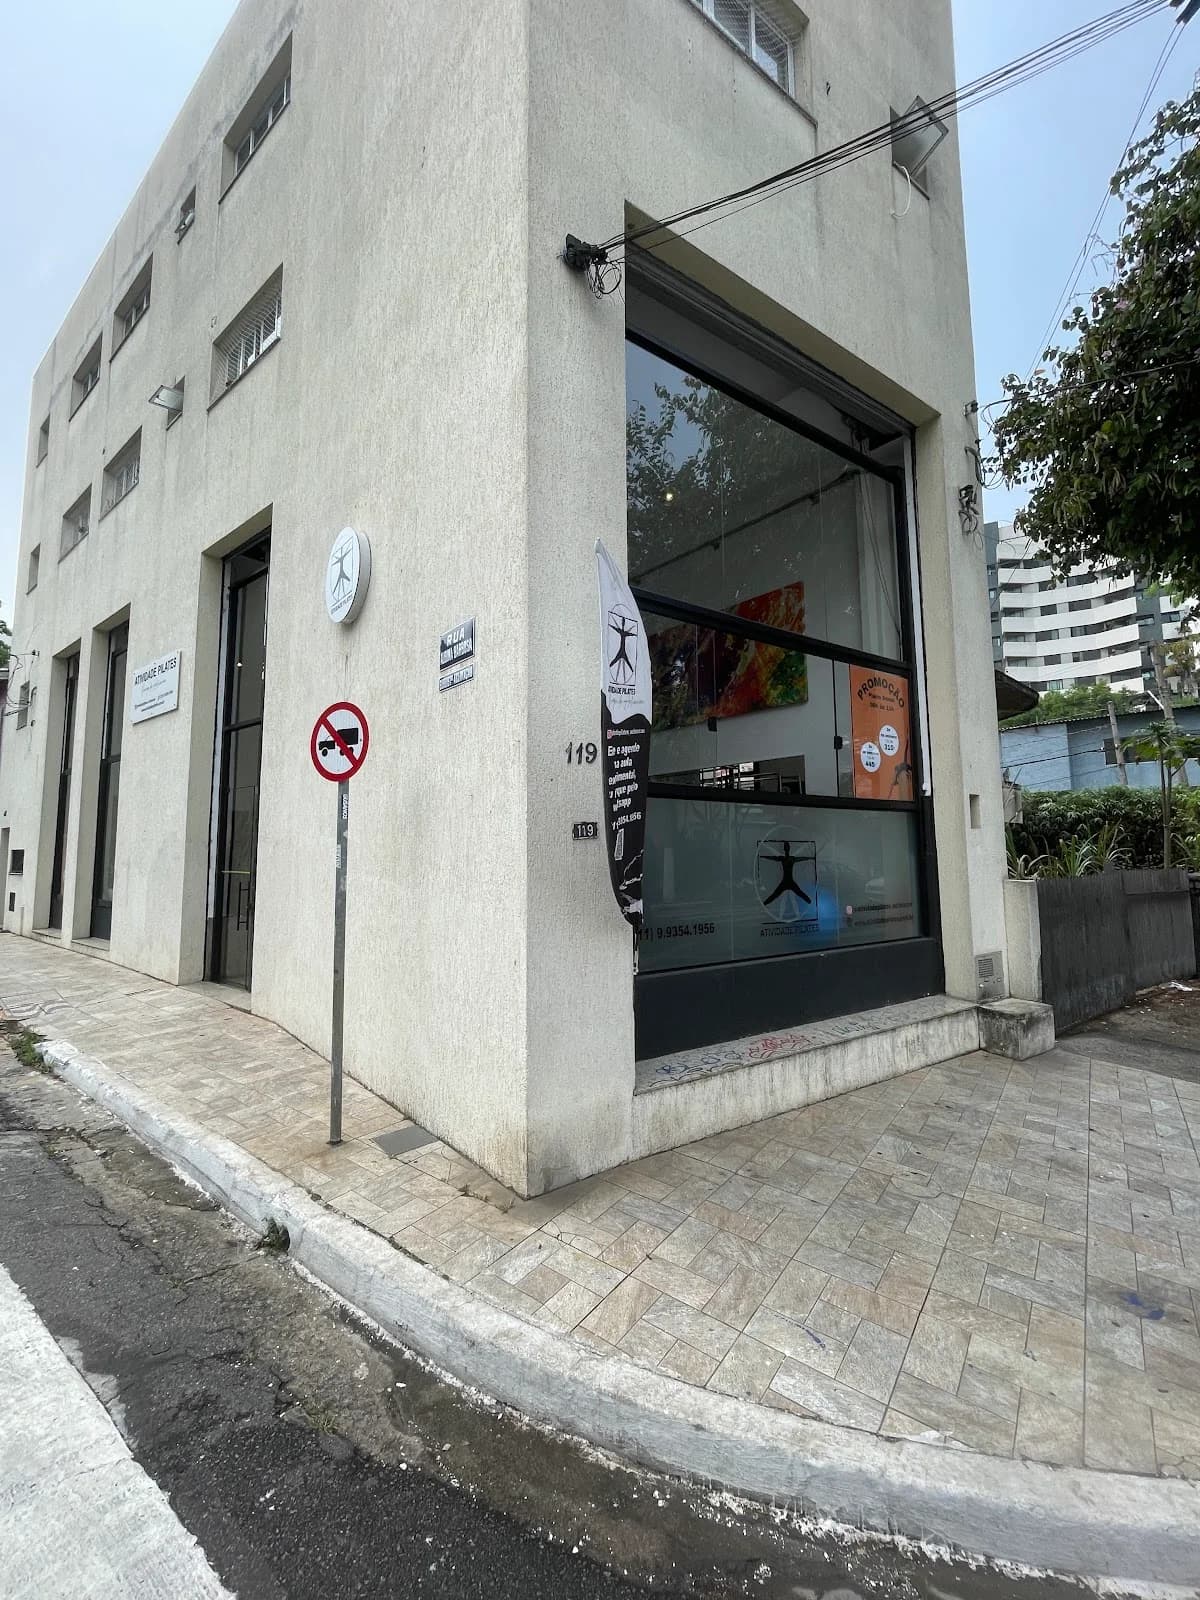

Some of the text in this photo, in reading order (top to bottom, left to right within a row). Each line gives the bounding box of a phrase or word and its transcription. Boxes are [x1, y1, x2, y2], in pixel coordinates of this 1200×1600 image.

[446, 627, 465, 648] RUA
[134, 667, 157, 686] ATIVIDADE
[157, 657, 177, 676] PILATES
[857, 677, 905, 708] PROMOÇÃO
[565, 742, 598, 764] 119
[577, 823, 594, 836] 119
[656, 922, 715, 940] 9.9354.1956
